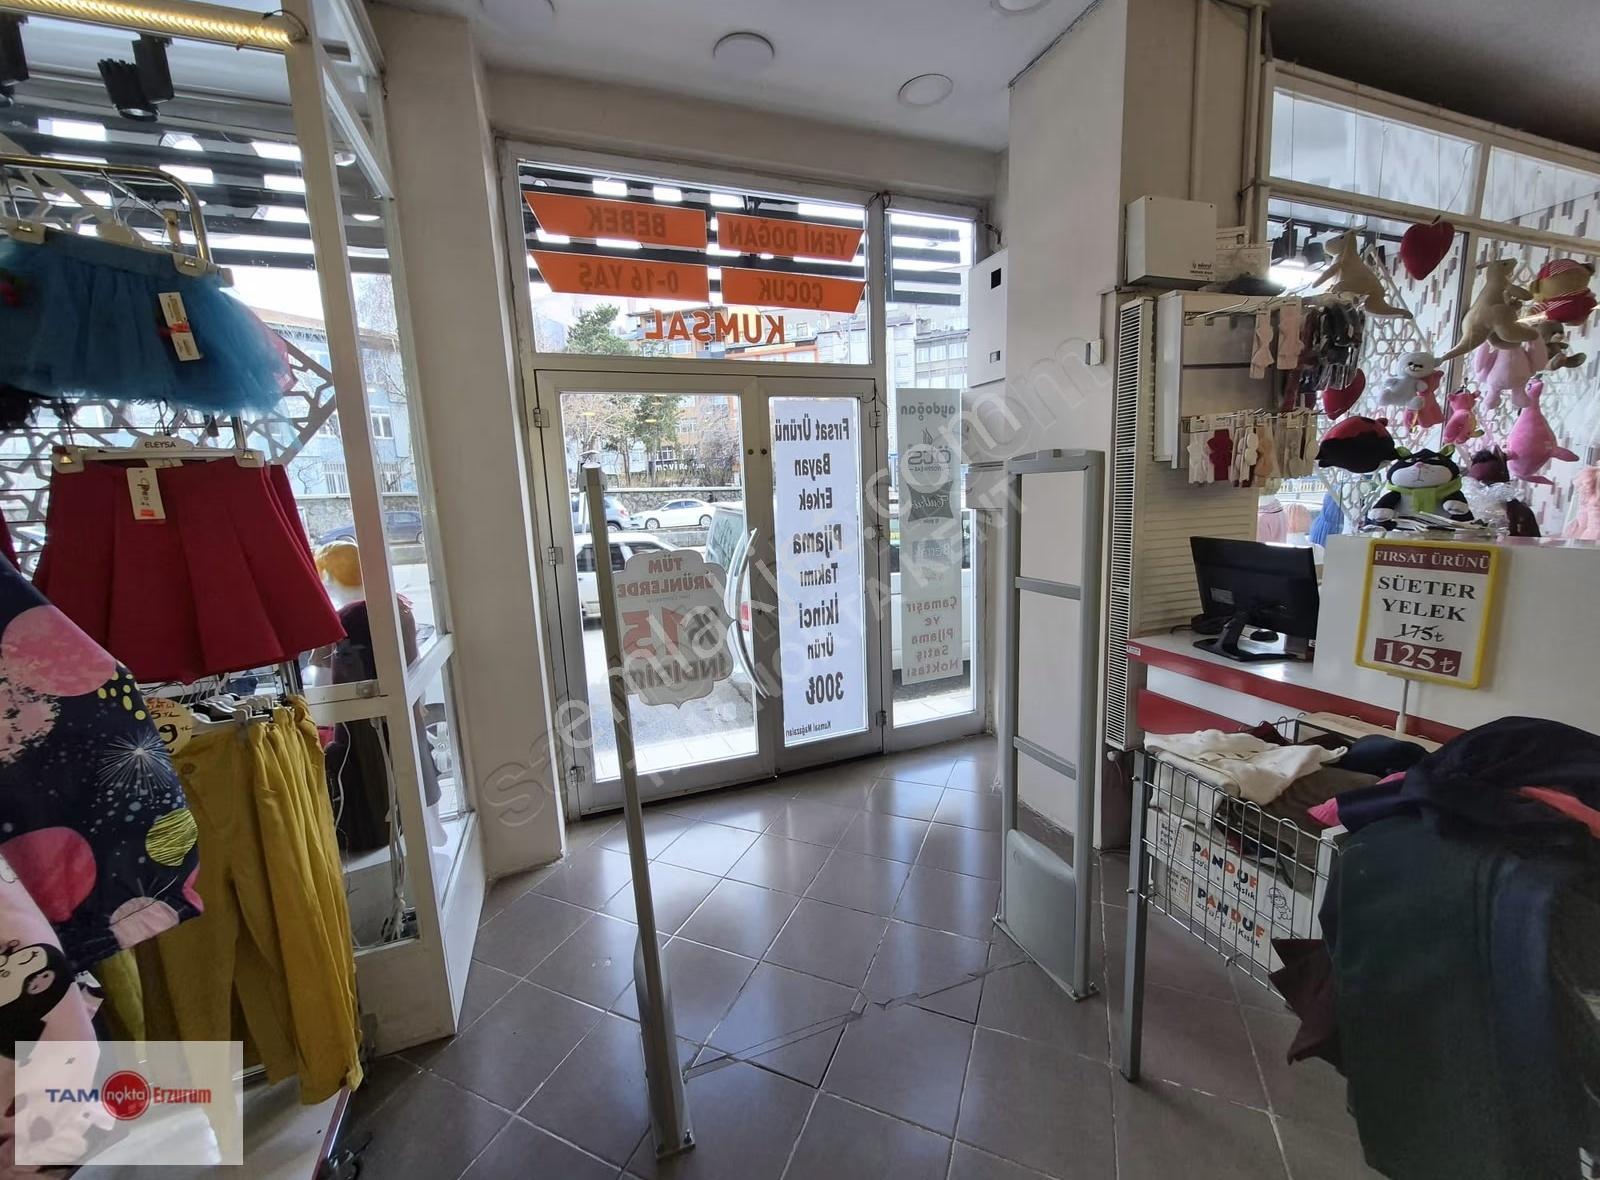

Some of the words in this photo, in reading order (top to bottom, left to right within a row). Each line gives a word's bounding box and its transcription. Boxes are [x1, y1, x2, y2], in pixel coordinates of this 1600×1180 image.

[1374, 550, 1427, 565] FIRSAT
[1431, 552, 1489, 570] ÜRÜNÜ
[1378, 574, 1476, 600] SÜETER
[1381, 598, 1467, 622] YELEK
